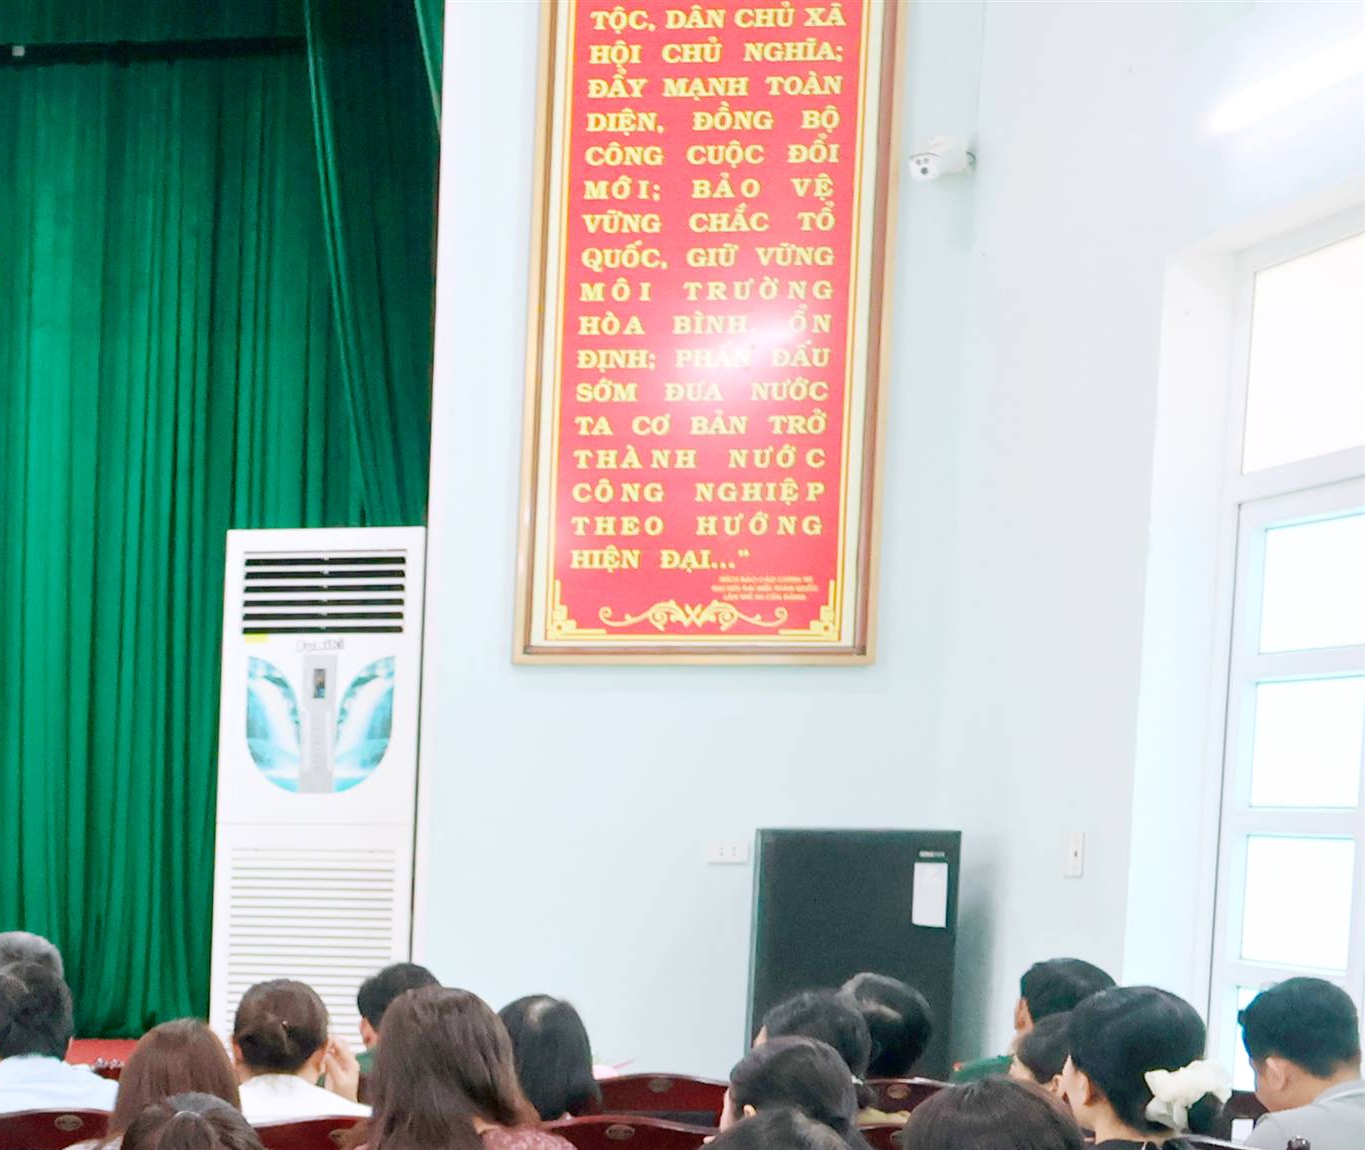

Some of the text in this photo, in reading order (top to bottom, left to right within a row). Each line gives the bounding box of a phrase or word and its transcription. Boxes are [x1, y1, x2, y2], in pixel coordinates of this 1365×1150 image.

[590, 1, 846, 34] TỘC, DÂN CHỦ XÃ
[589, 36, 843, 67] HỘI CHỦ NGHĨA;
[587, 66, 843, 101] ĐẨY MẠNH TOÀN
[692, 101, 774, 131] ĐỒNG
[801, 105, 840, 133] BỘ
[585, 133, 840, 168] CÔNG CUỘC ĐỔI
[691, 172, 760, 198] BẢO
[790, 173, 834, 201] VỆ
[581, 201, 835, 234] VỮNG CHẮC TỔ
[686, 243, 739, 267] GIỮ
[755, 242, 835, 267] VỮNG
[579, 277, 833, 302] MÔI TRƯỜNG
[577, 311, 646, 336] HÒA
[577, 348, 656, 374] ĐỊNH;
[772, 340, 831, 369] ĐẤU
[575, 377, 829, 404] SỚM ĐƯA NƯỚC
[574, 408, 827, 436] TA CƠ BẢN TRỞ
[573, 444, 825, 469] THÀNH NƯỚC
[572, 477, 825, 506] CÔNG NGHIỆP
[570, 511, 822, 536] THEO HƯỚNG
[570, 544, 641, 573] HIỆN
